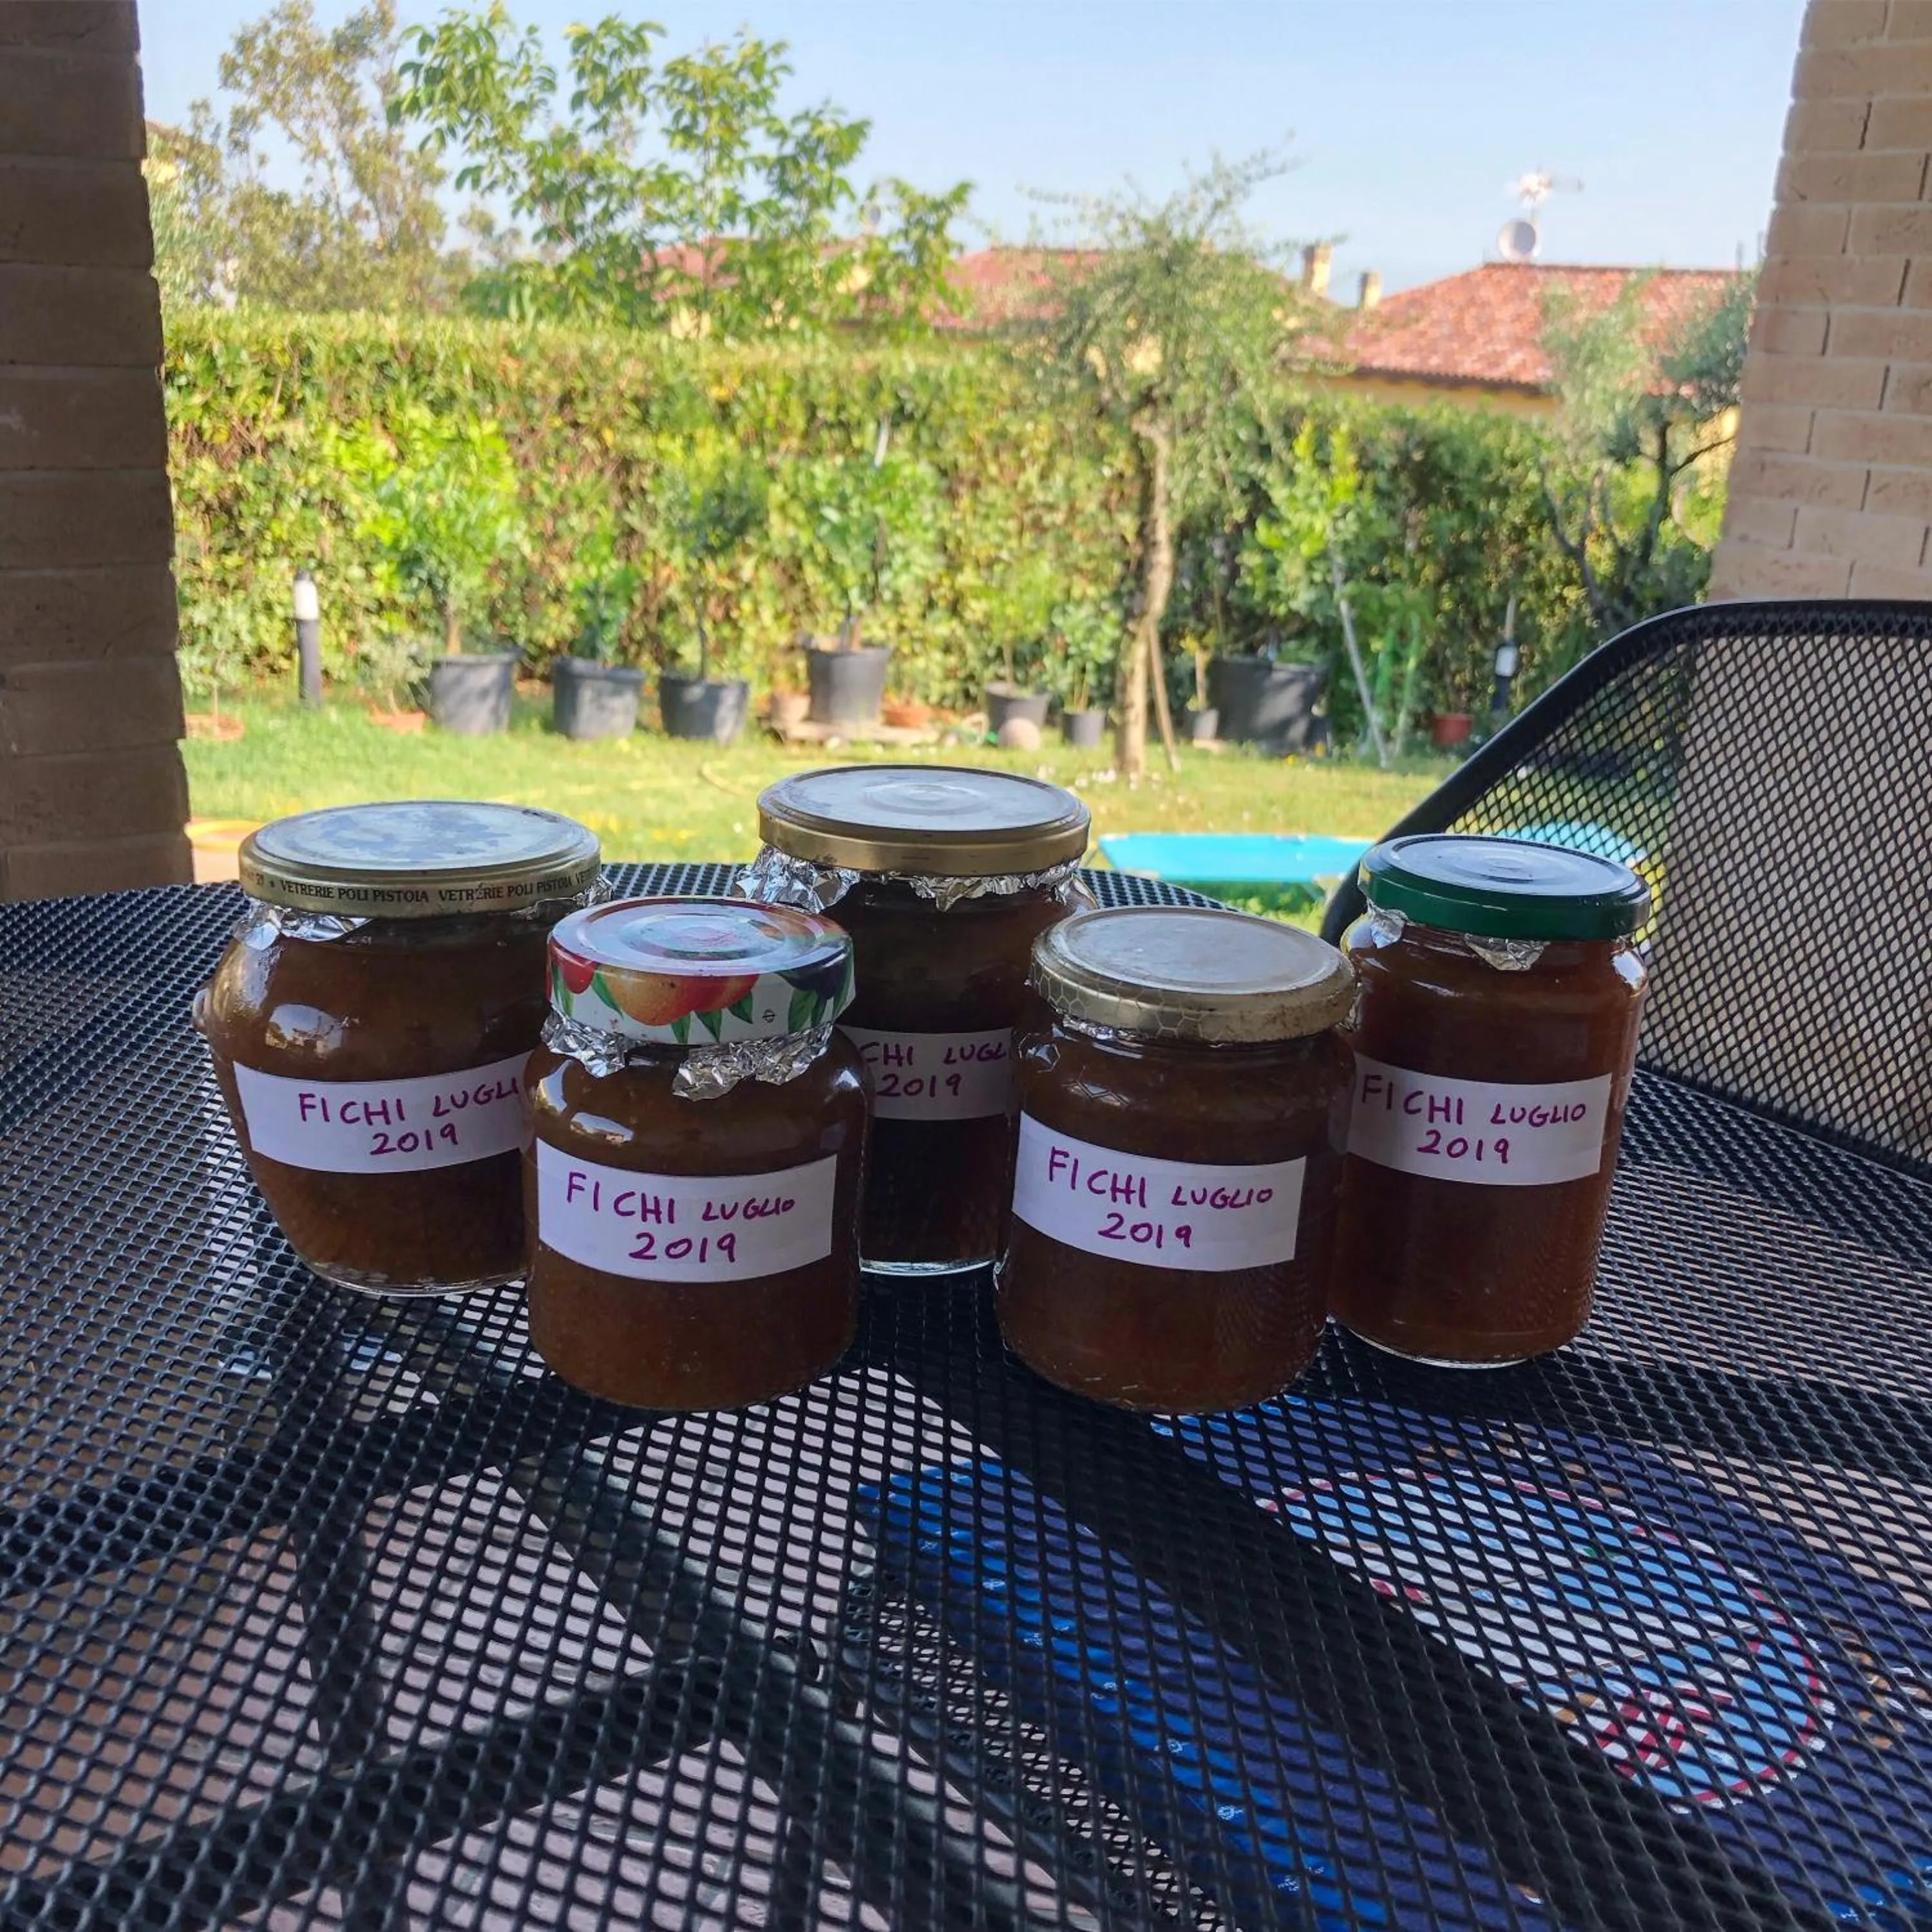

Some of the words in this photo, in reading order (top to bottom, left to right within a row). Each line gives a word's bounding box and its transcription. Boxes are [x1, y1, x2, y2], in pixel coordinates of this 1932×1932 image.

[279, 879, 334, 898] VETRERIE
[337, 888, 368, 902] POLI
[372, 889, 430, 904] PISTOIA
[507, 884, 533, 898] POLI
[536, 875, 573, 893] PISTOIA
[860, 1041, 914, 1067] CHI
[943, 1041, 1007, 1065] LUGL
[298, 1092, 405, 1126] FICHI
[431, 1077, 519, 1117] LUGLI
[876, 1073, 962, 1098] 2019
[1361, 1074, 1464, 1125] FICHI
[1490, 1102, 1587, 1128] LUGLIO
[370, 1122, 459, 1156] 2019
[1416, 1129, 1510, 1164] 2019
[1048, 1146, 1147, 1208] FICHI
[1171, 1185, 1274, 1209] LUGLIO
[566, 1171, 675, 1224] FICHI
[701, 1196, 796, 1222] LUGLIO
[628, 1231, 737, 1264] 2019
[1097, 1212, 1193, 1249] 2019
